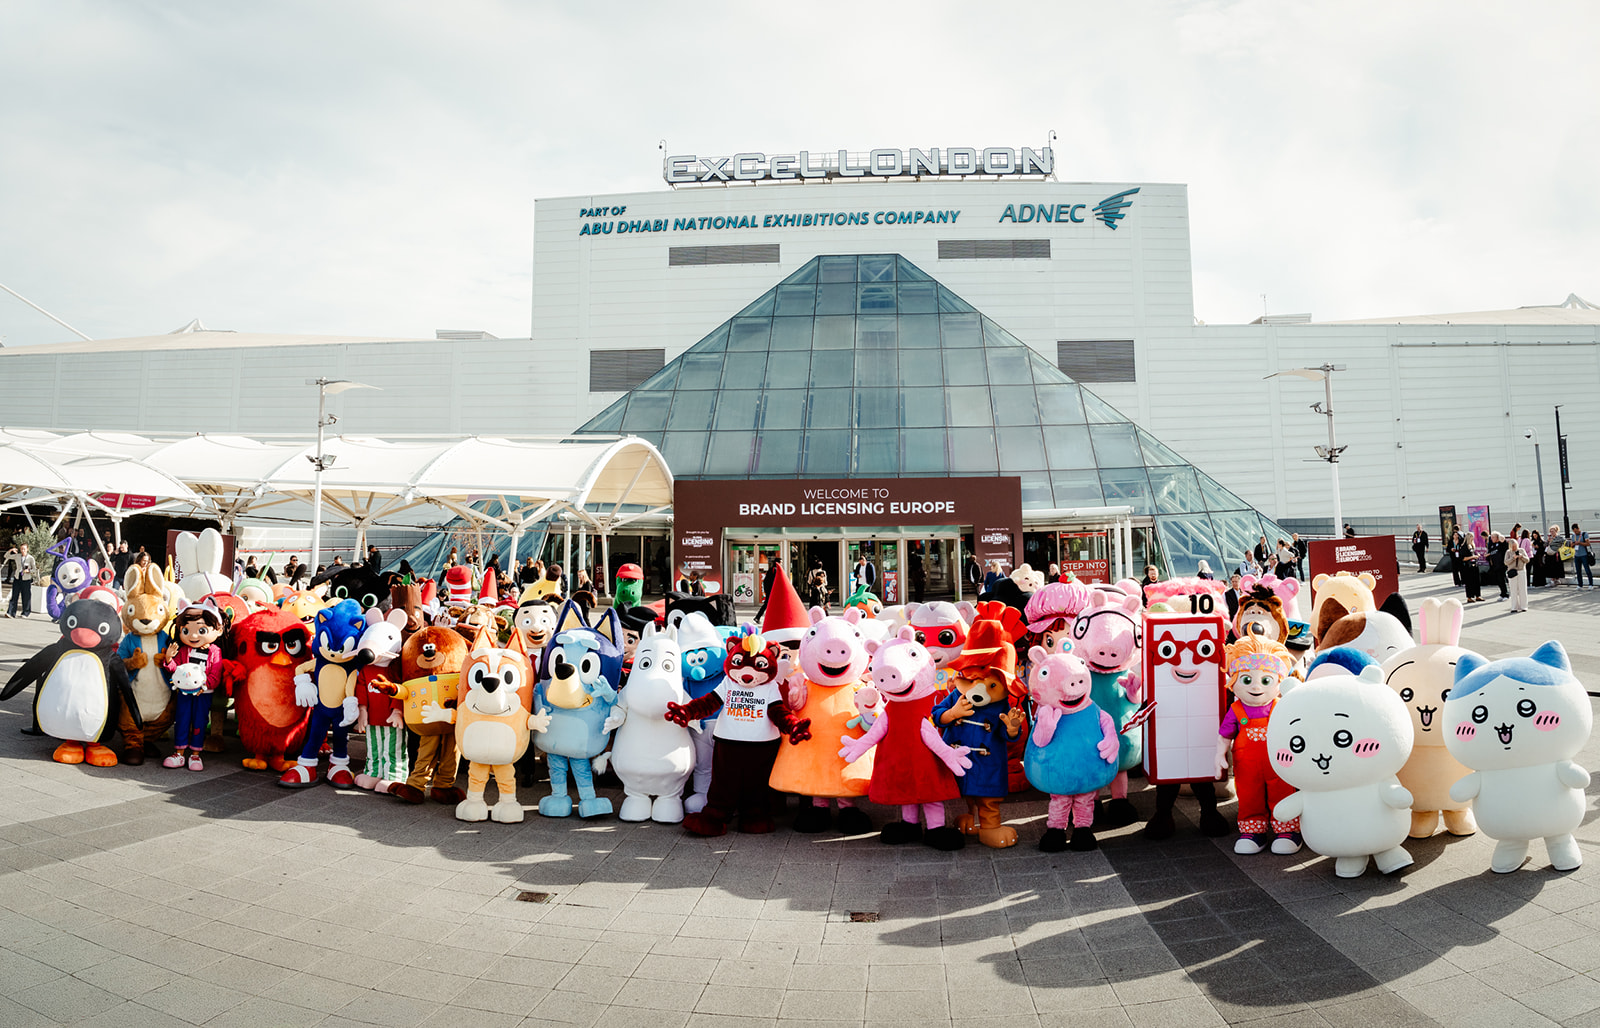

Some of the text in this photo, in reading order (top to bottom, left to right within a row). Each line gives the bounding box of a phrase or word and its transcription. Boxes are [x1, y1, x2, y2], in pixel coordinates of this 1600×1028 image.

[837, 146, 1052, 177] LONDON
[579, 205, 627, 217] PART OF
[999, 203, 1087, 223] ADNEC
[579, 209, 961, 236] ABU DHABI NATIONAL EXHIBITIONS COMPANY
[803, 488, 890, 500] WELCOME TO
[739, 501, 956, 515] BRAND LICENSING EUROPE
[682, 537, 714, 545] LICENSING
[1062, 561, 1107, 571] STEP INTO
[1188, 593, 1214, 615] 10
[730, 702, 756, 710] EUROPE
[731, 696, 765, 705] LICENSING
[727, 707, 763, 719] MABLE
